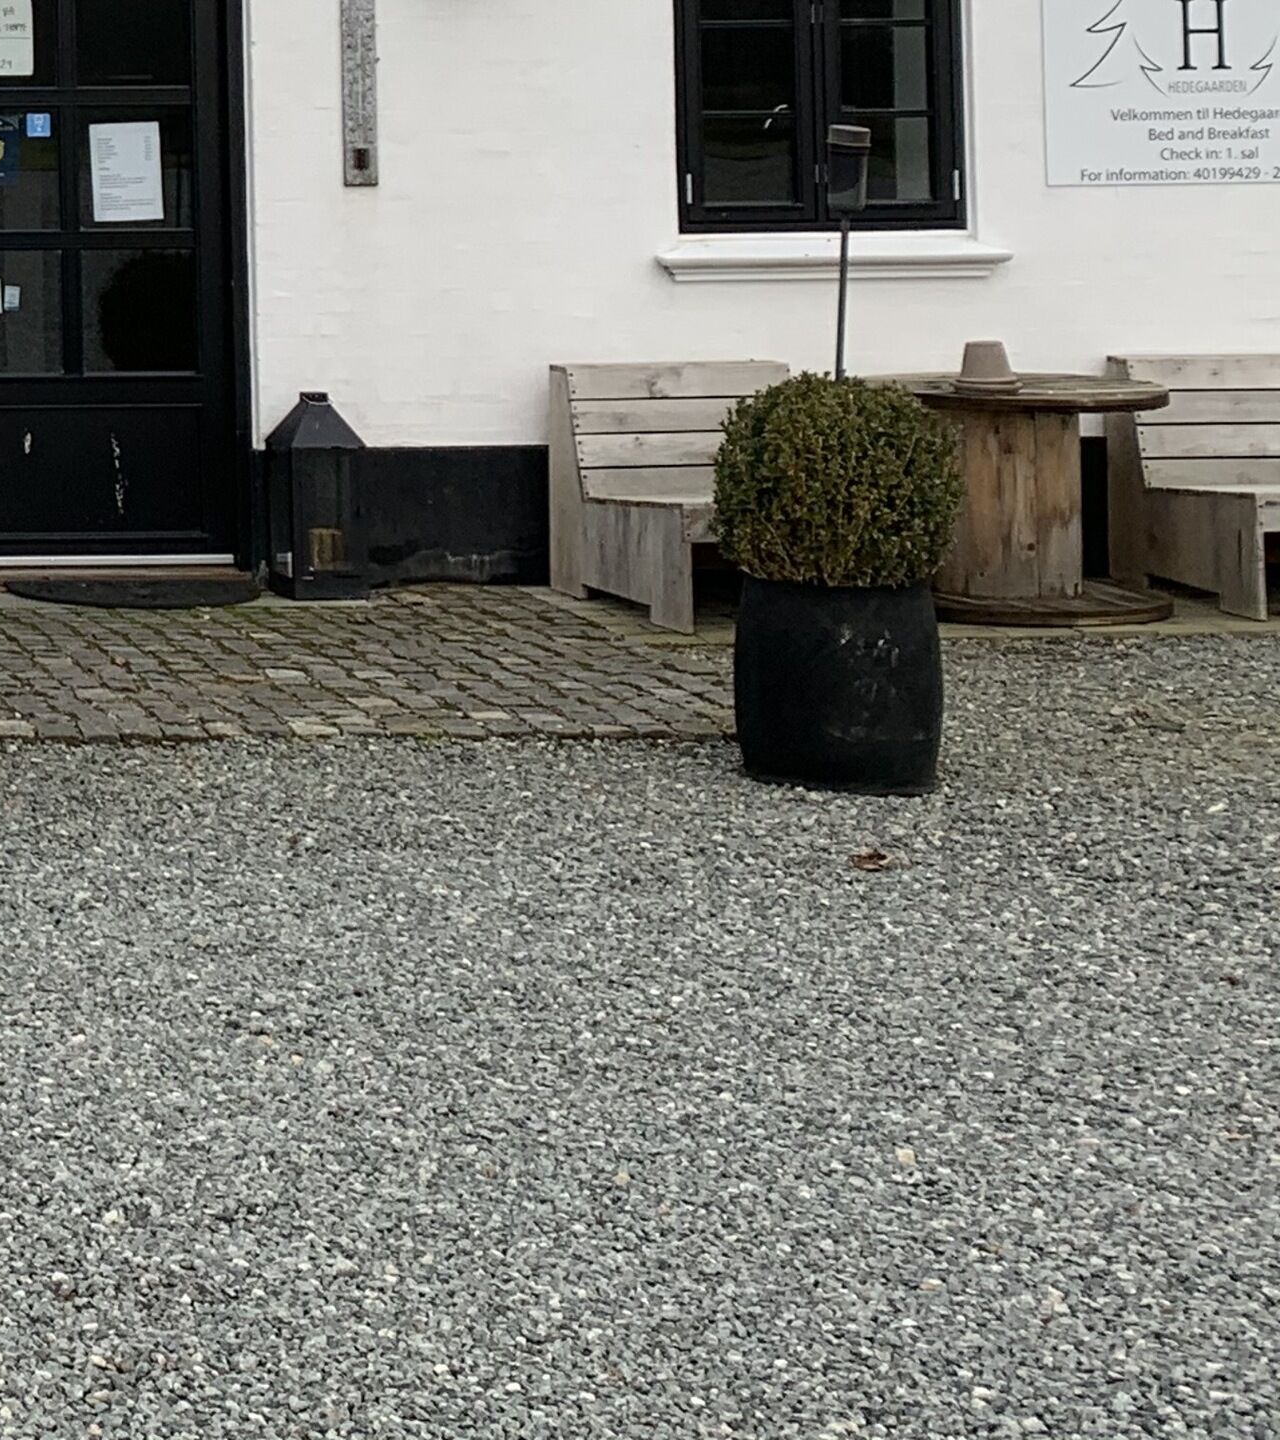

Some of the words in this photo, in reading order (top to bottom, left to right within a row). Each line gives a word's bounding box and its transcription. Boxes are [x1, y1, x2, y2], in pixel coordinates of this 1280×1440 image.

[1168, 80, 1247, 94] HEDEGAARDEN
[1110, 108, 1193, 121] Velkommen
[1196, 108, 1209, 120] til
[1148, 128, 1174, 141] Bed
[1178, 127, 1204, 140] and
[1207, 126, 1270, 140] Breakfast
[1160, 147, 1202, 161] Check
[1205, 148, 1222, 159] in:
[1240, 146, 1259, 159] sal
[1081, 169, 1102, 181] For
[1106, 168, 1190, 181] information:
[1193, 166, 1261, 179] 40199429
